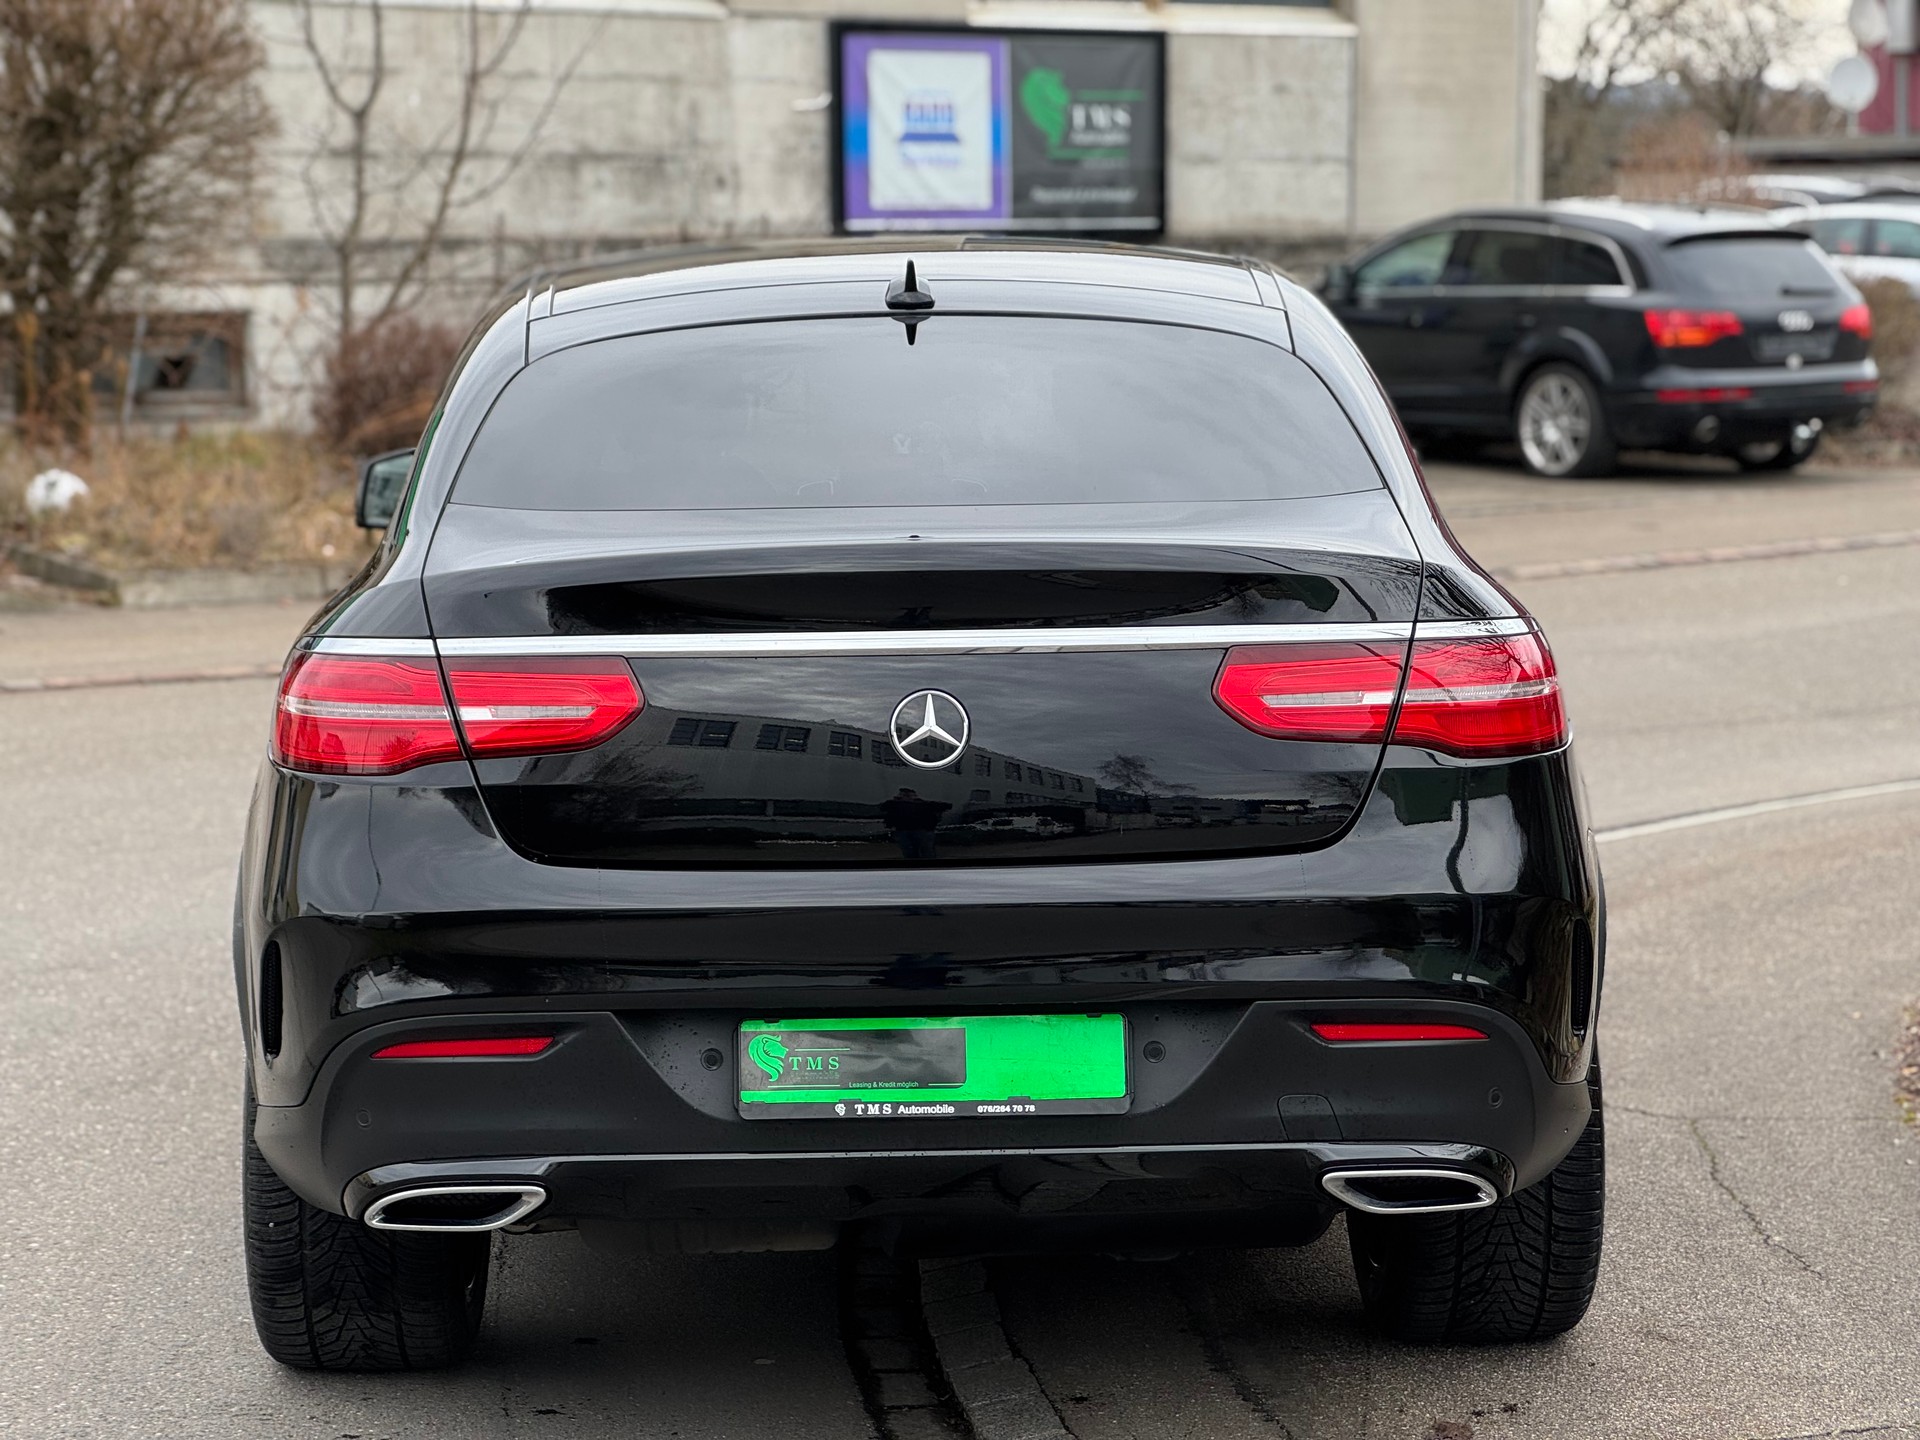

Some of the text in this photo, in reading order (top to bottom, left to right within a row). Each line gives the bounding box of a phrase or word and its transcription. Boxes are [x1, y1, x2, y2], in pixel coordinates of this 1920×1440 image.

[788, 1056, 840, 1070] TMS
[854, 1103, 955, 1115] TMS Automobile
